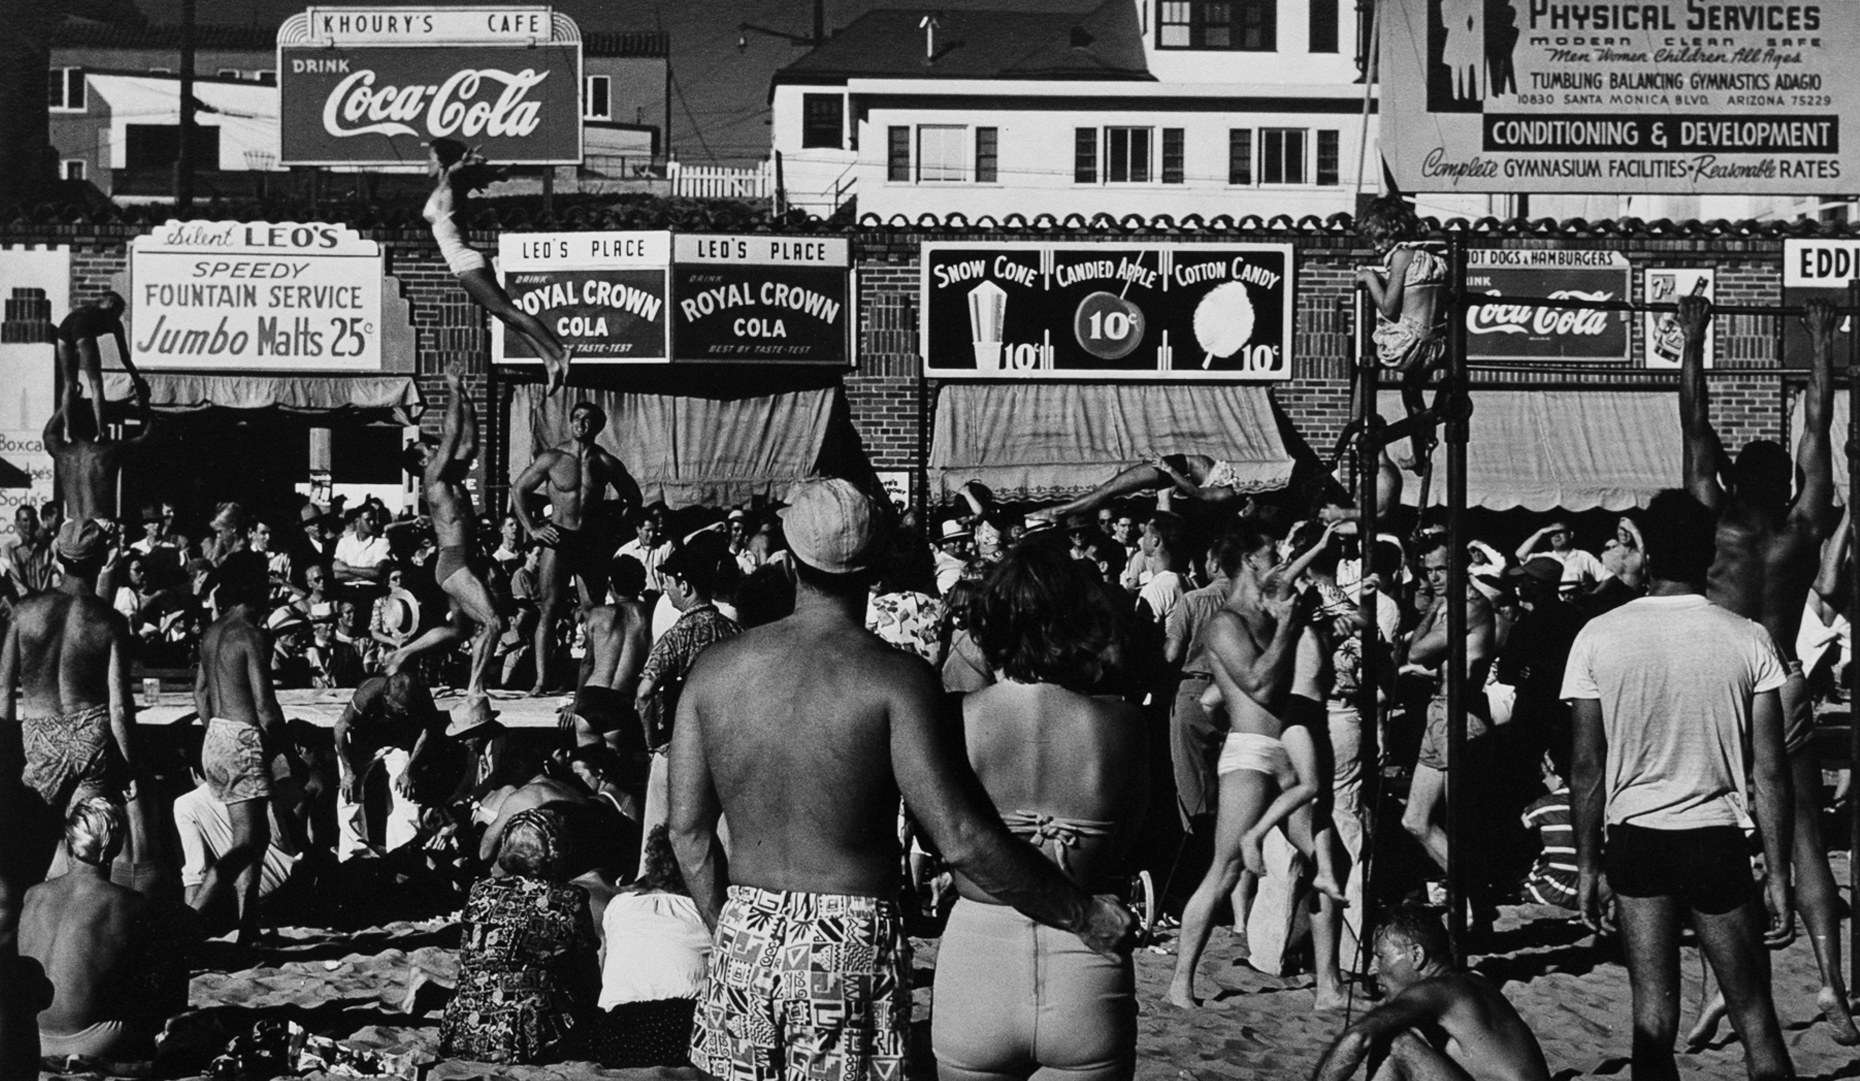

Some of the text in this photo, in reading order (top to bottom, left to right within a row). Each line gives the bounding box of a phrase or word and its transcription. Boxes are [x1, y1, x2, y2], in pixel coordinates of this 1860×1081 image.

[323, 14, 540, 34] KHOURY'S CAFE
[1529, 0, 1821, 31] PHYSICAL SERVICES
[1664, 37, 1735, 47] CLEAN
[1766, 37, 1822, 47] SAFE
[1544, 48, 1591, 63] Men
[1594, 48, 1649, 63] Women
[1653, 46, 1729, 64] Children
[1731, 47, 1761, 64] All
[292, 58, 350, 74] DRINK
[1530, 72, 1822, 91] TUMBLING BALANCING GYMNASTICS ADAGIO
[322, 68, 550, 138] Coca-Cola
[1517, 94, 1555, 105] 10830
[1563, 94, 1603, 105] SANTA
[1609, 94, 1670, 105] MONICA
[1726, 95, 1785, 106] ARIZONA
[1791, 95, 1832, 106] 75229
[1492, 120, 1832, 149] CONDITIONING & DEVELOPMENT
[1422, 147, 1498, 186] Complete
[1504, 159, 1602, 178] GYMNASIUM
[1780, 160, 1841, 179] RATES
[167, 225, 339, 249] Silent LEO'S
[523, 238, 645, 259] LEO'S PLACE
[697, 238, 826, 260] LEO'S PLACE
[1468, 251, 1485, 264] OT
[1490, 250, 1521, 264] DOGS
[1530, 251, 1613, 266] HAMBURGERS
[192, 261, 311, 279] SPEEDY
[515, 274, 549, 284] DRINK
[933, 254, 1038, 289] SNOW CONE
[1055, 256, 1158, 289] CANDIED APPLE
[1175, 256, 1281, 290] COTTON CANDY
[1466, 276, 1492, 287] INK
[145, 284, 364, 309] FOUNTAIN SERVICE
[583, 280, 662, 323] CROWN
[681, 281, 841, 325] ROYAL CROWN
[136, 314, 249, 356] Jumbo
[257, 316, 323, 356] Malts
[557, 317, 609, 337] COLA
[733, 317, 787, 338] COLA
